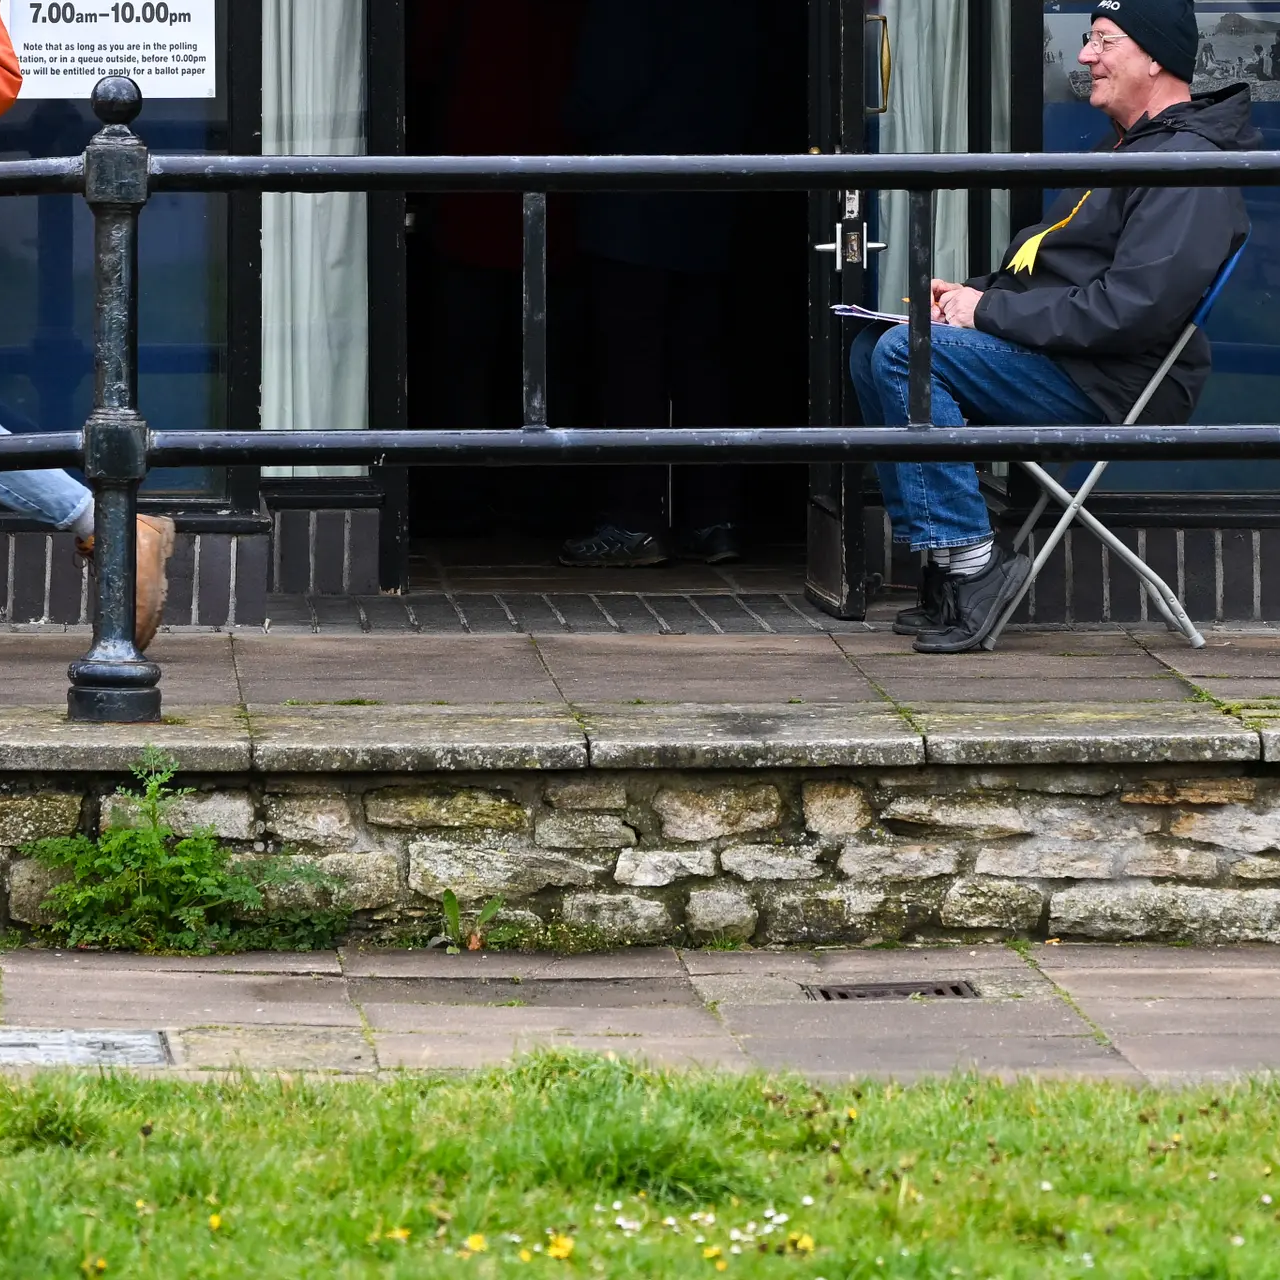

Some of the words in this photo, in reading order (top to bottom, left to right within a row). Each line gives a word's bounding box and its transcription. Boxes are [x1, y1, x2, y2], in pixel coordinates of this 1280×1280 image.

[23, 42, 43, 51] Note
[44, 42, 63, 51] that
[64, 43, 75, 51] as
[76, 42, 95, 53] long
[97, 43, 108, 51] as
[109, 43, 125, 53] you
[126, 43, 141, 51] are
[142, 41, 151, 51] in
[152, 41, 167, 51] the
[168, 41, 198, 53] polling
[48, 56, 58, 64] or
[59, 54, 68, 63] in
[77, 56, 104, 65] queue
[105, 54, 140, 65] outside,
[141, 53, 169, 63] before
[171, 53, 207, 65] 10.00pm
[19, 68, 31, 76] ou
[32, 66, 49, 76] will
[50, 66, 61, 76] be
[62, 66, 96, 76] entitled
[97, 66, 107, 76] to
[107, 66, 131, 78] apply
[132, 66, 145, 76] for
[154, 66, 179, 76] ballot
[180, 67, 207, 77] paper
